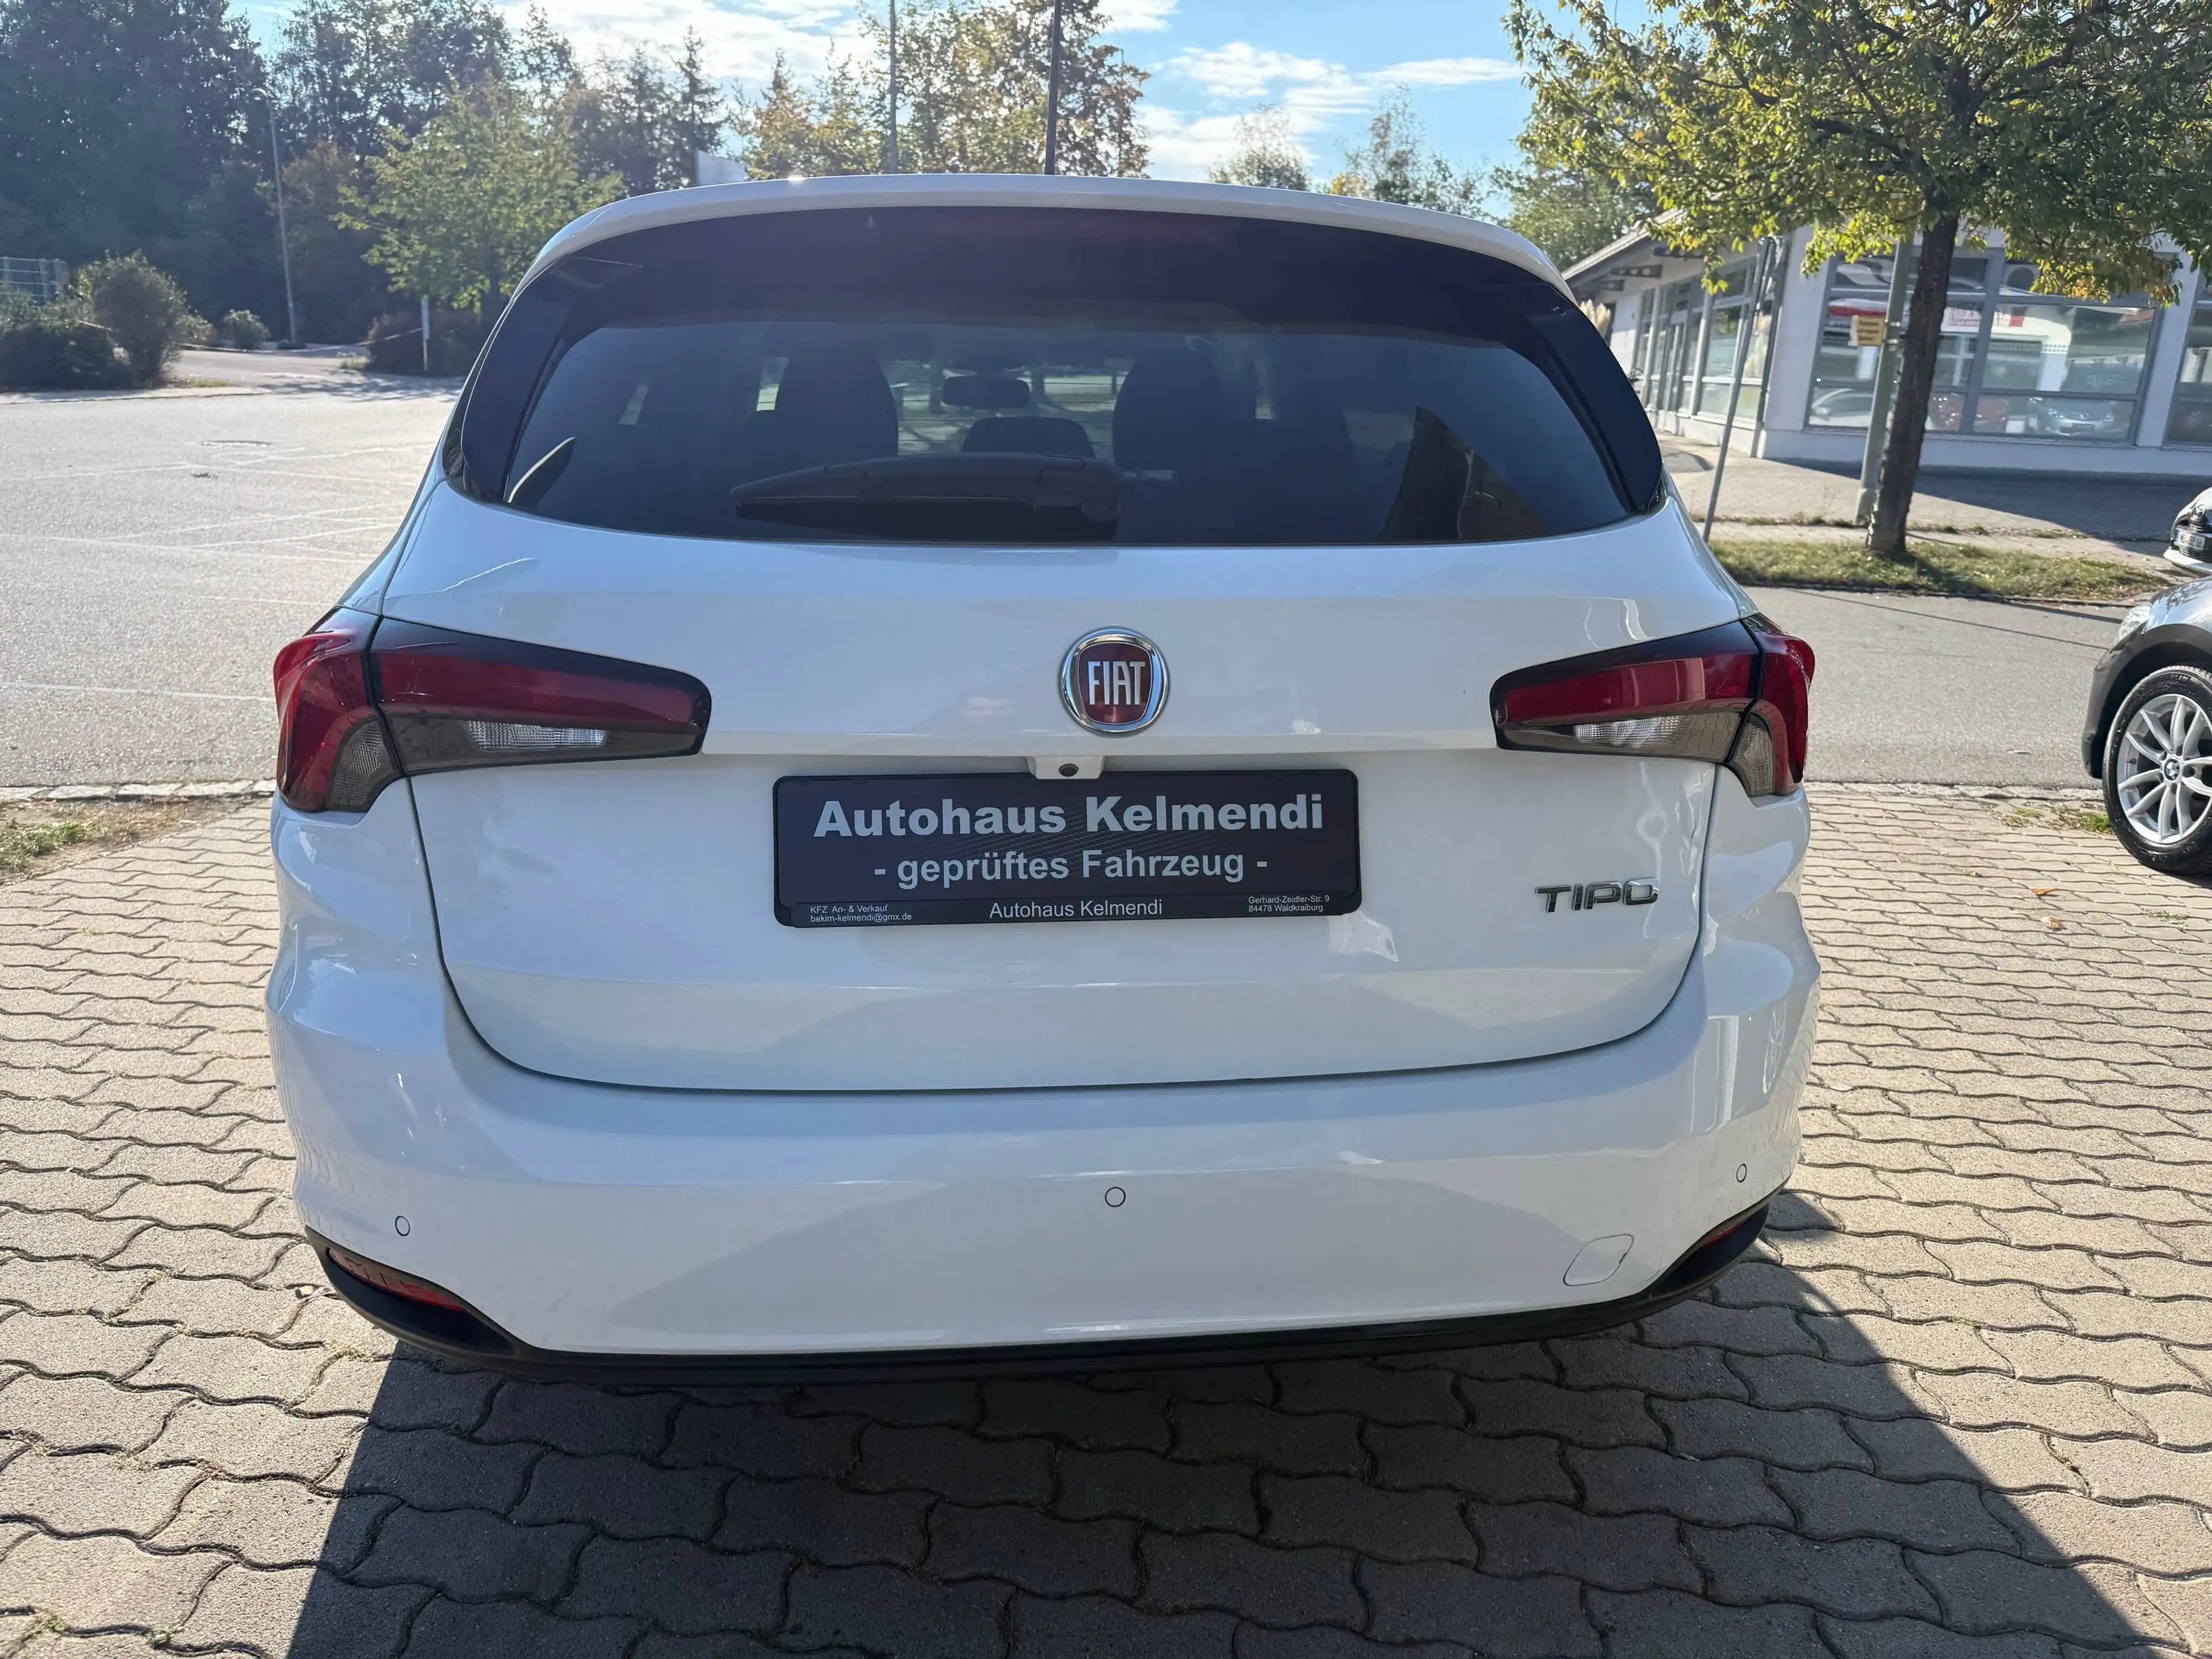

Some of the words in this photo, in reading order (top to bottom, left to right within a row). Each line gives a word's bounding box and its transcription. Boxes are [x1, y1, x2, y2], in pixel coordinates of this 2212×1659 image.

[1088, 661, 1146, 705] FIAT
[813, 798, 1066, 837] Autohaus
[1086, 794, 1323, 832] Kelmendi
[897, 851, 1069, 889] geprüftes
[1082, 849, 1244, 882] Fahrzeug
[1274, 904, 1323, 912] Waldkraiburg
[1535, 877, 1660, 912] TIPO
[810, 906, 828, 914] KFZ
[857, 904, 888, 912] Verkauf
[810, 913, 912, 922] bekim-kelmendi@gmx.de
[989, 901, 1074, 918] Autohaus
[1081, 899, 1162, 916] Kelmendi
